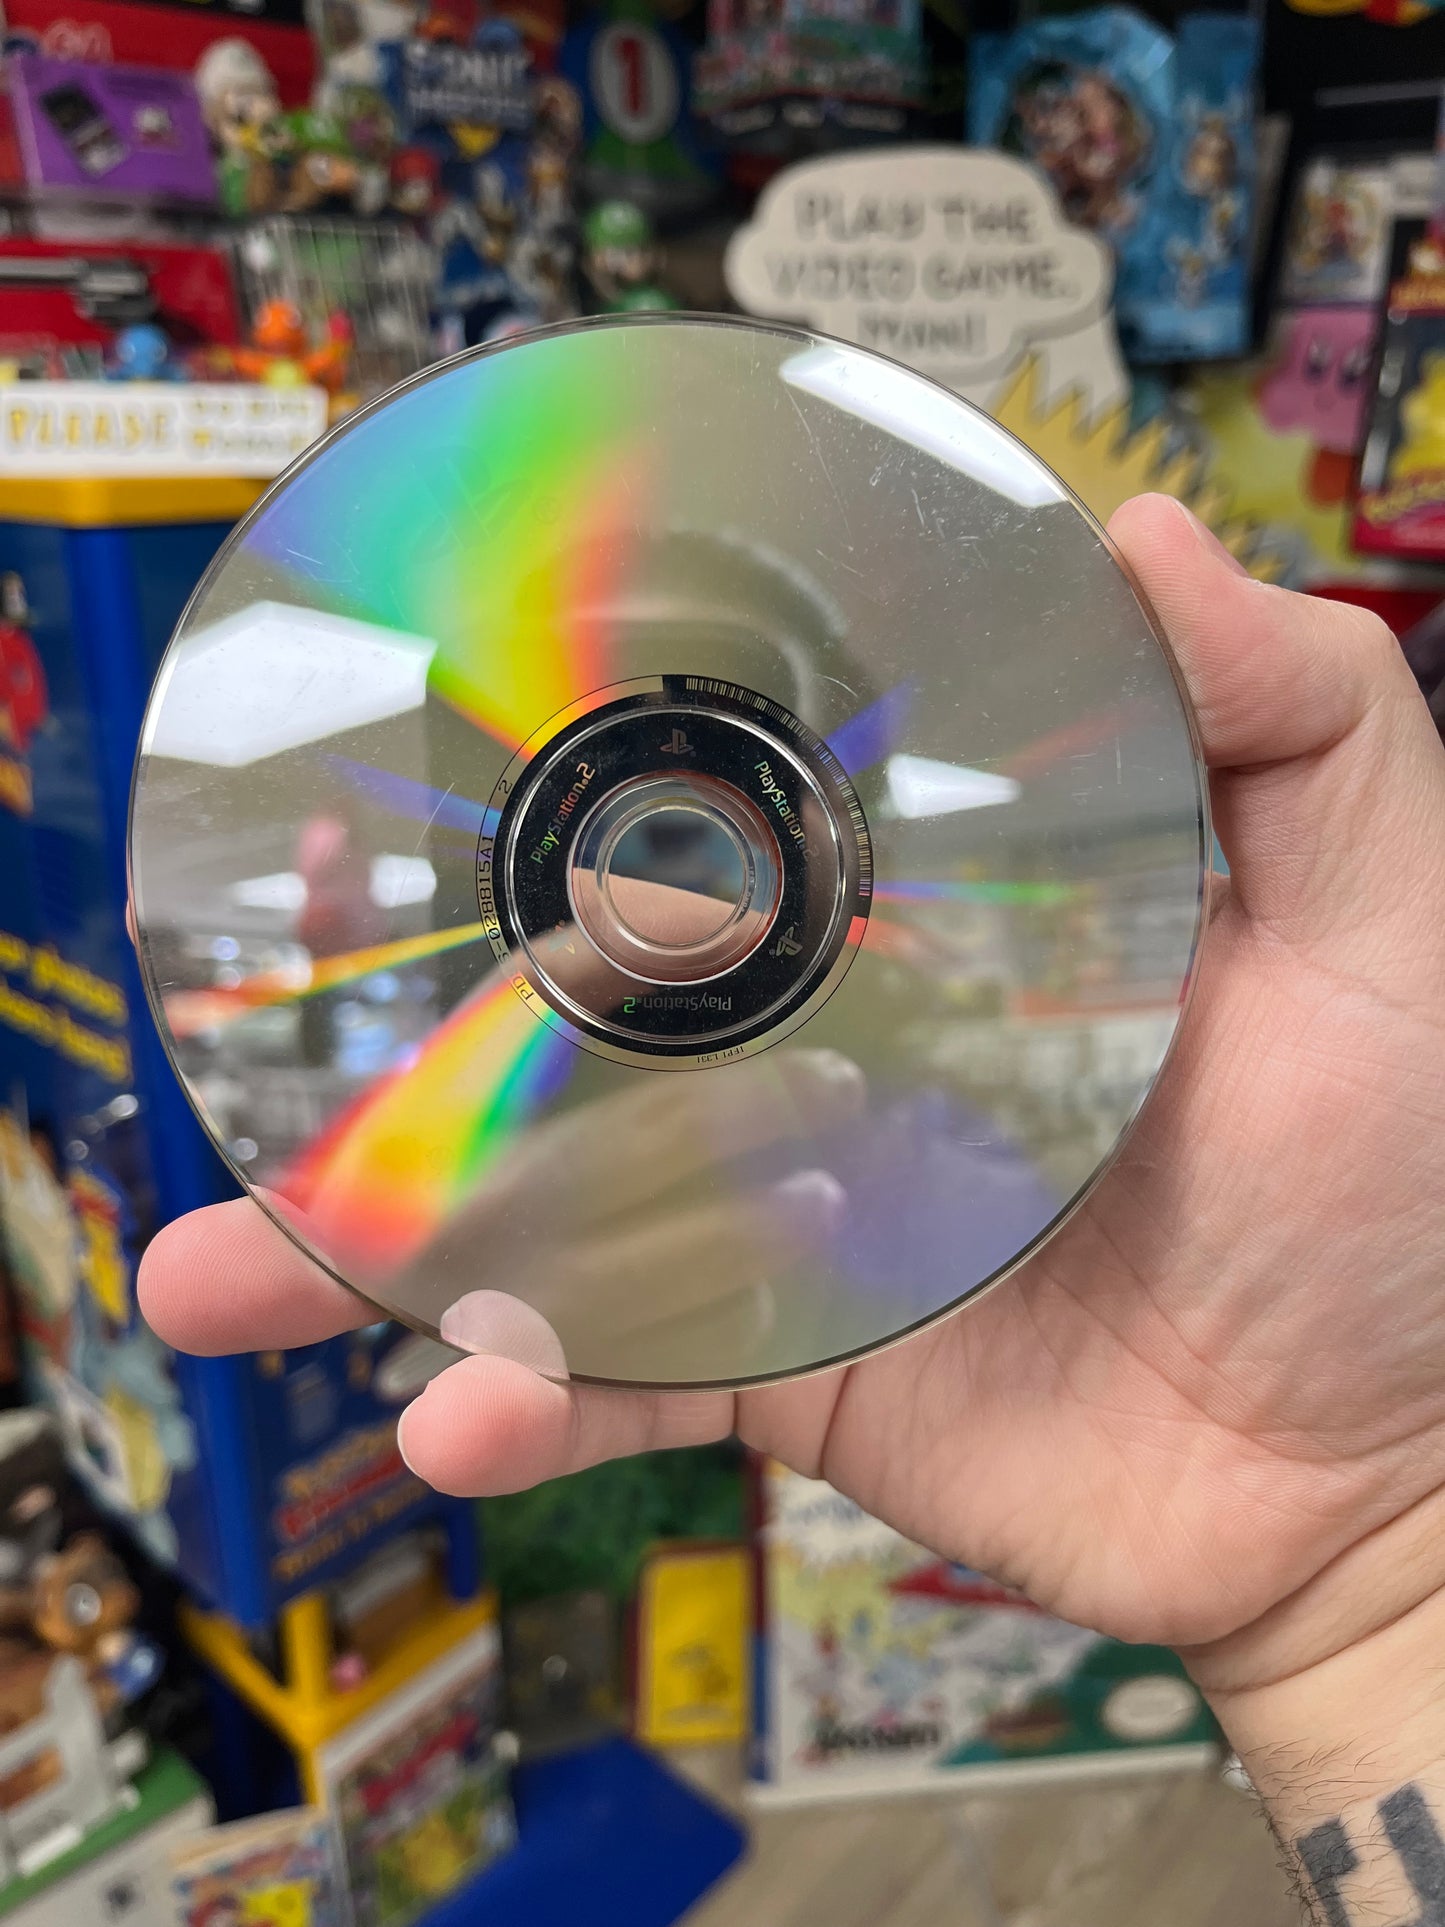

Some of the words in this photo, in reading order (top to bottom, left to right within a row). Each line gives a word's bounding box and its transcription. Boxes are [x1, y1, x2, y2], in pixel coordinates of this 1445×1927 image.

[795, 190, 926, 244] PLAY
[930, 192, 1041, 246] THE
[765, 250, 917, 302] VIDEO
[6, 402, 174, 449] PLEASE
